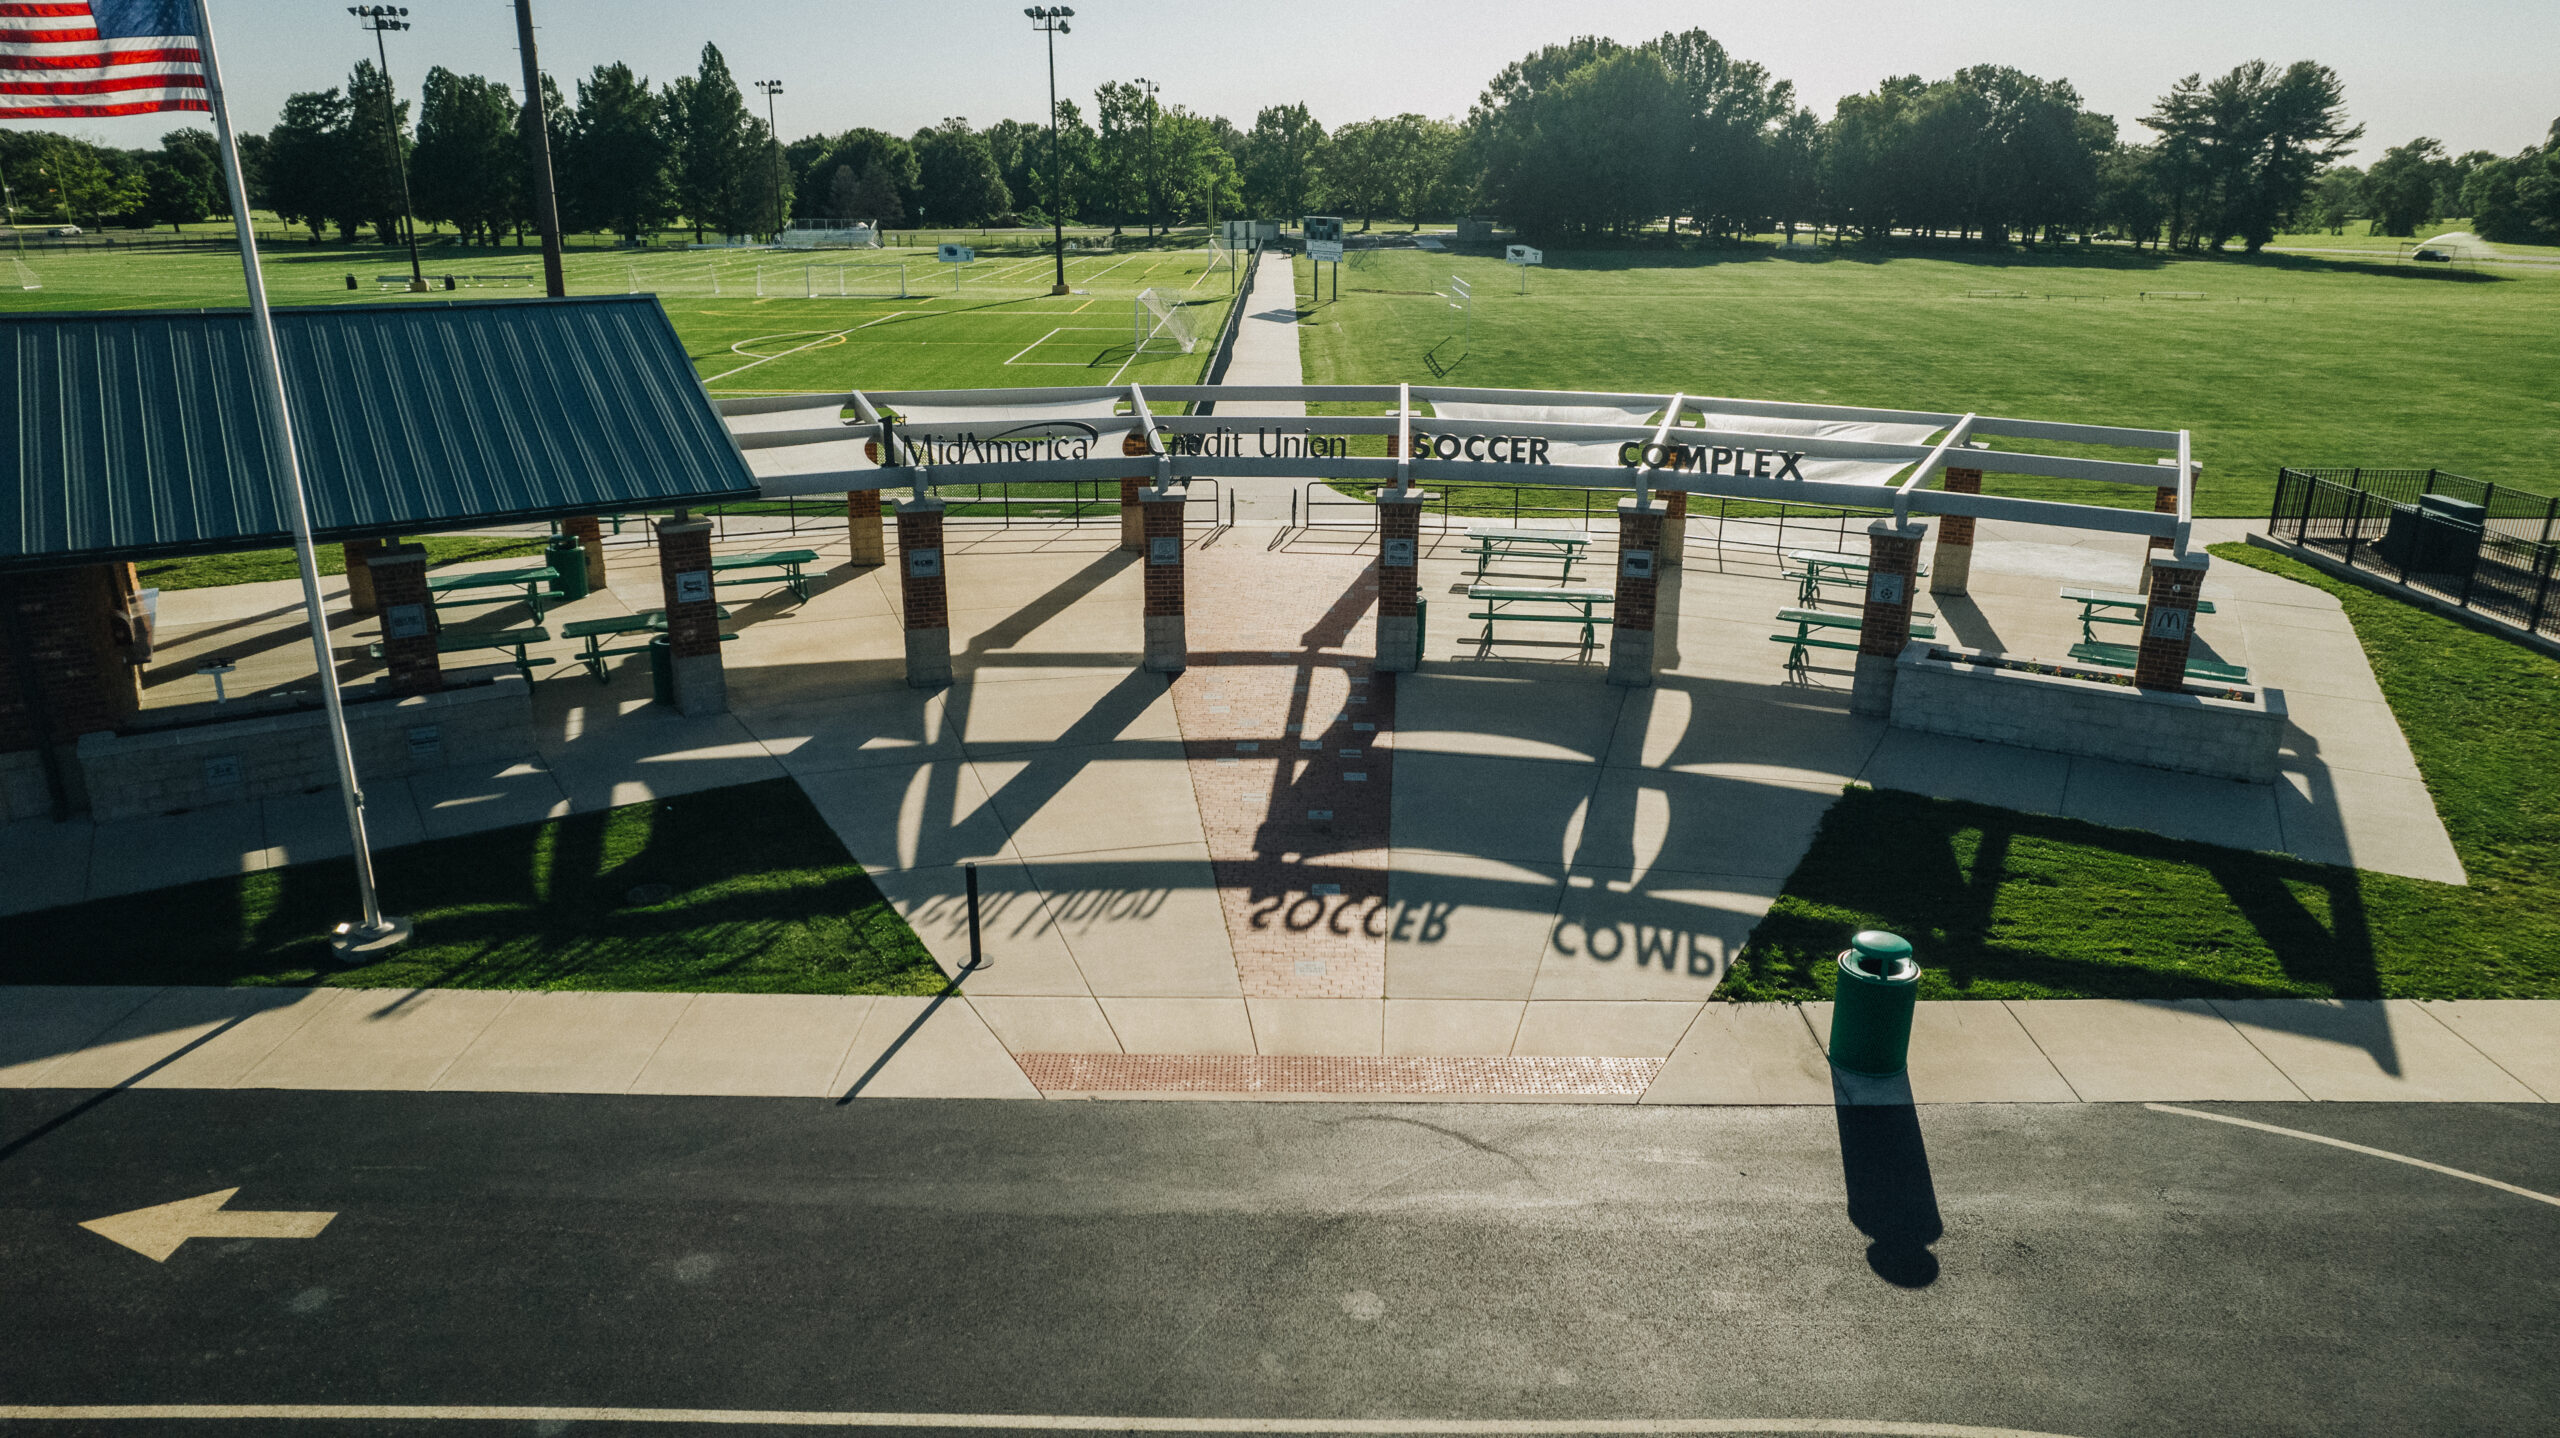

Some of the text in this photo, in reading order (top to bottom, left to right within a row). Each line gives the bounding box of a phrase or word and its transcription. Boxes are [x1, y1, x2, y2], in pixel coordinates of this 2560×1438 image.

[903, 430, 1089, 467] MidAmerica
[1259, 426, 1347, 459] Union
[1413, 431, 1805, 481] SOCCER COMPLEX
